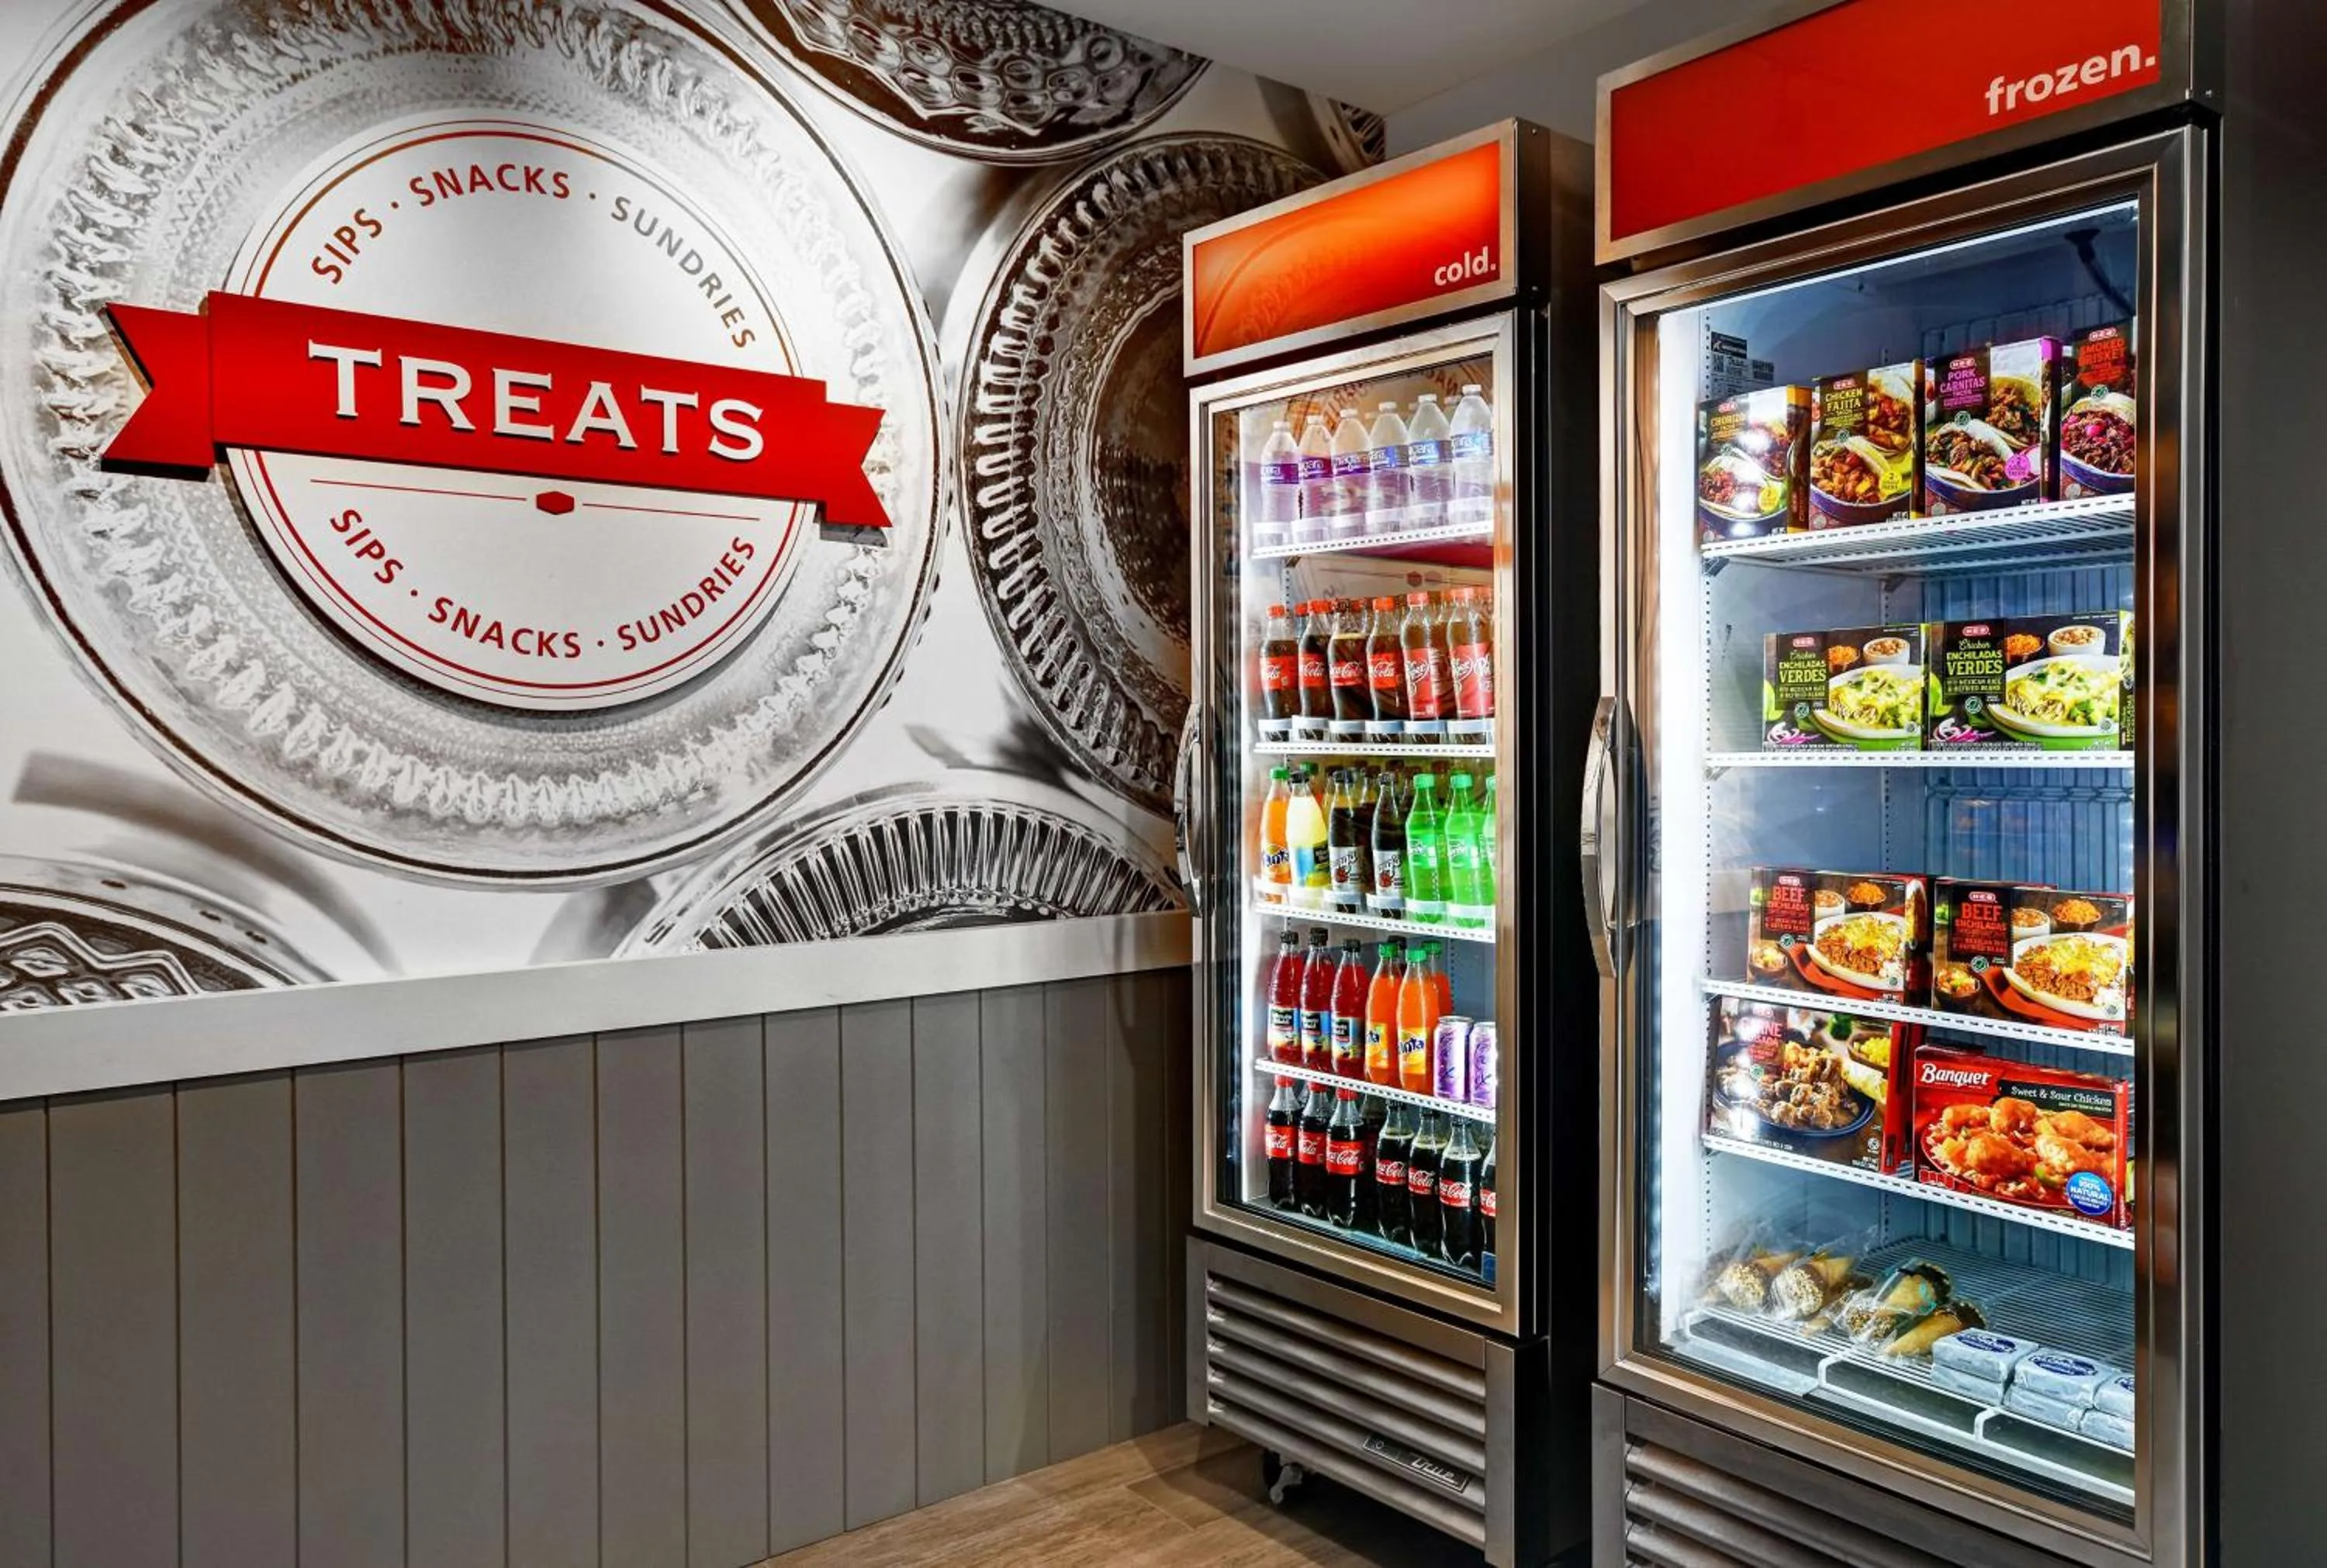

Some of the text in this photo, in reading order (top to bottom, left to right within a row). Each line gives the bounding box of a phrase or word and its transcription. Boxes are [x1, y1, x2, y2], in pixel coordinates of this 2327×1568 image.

[1985, 44, 2156, 116] frozen.
[311, 163, 756, 350] SIPS SNACKS SUNDRIES
[1434, 246, 1496, 286] cold.
[1948, 368, 1976, 381] PORK
[1940, 376, 1985, 393] CARNITAS
[307, 338, 765, 463] TREATS
[1825, 388, 1862, 402] CHICKEN
[1827, 398, 1861, 411] FAJITA
[330, 508, 755, 659] SIPS SNACKS SUNDRIES
[1946, 649, 2003, 661] ENCHILADAS
[1779, 660, 1827, 669] ENCHILADAS
[1946, 659, 2004, 676] VERDES
[1779, 669, 1827, 683] VERDES
[1772, 885, 1806, 903] BEEF
[1962, 902, 2003, 922] BEEF
[1921, 1063, 1992, 1088] Banquet
[2011, 1086, 2112, 1107] Sweet & Sour Chicken
